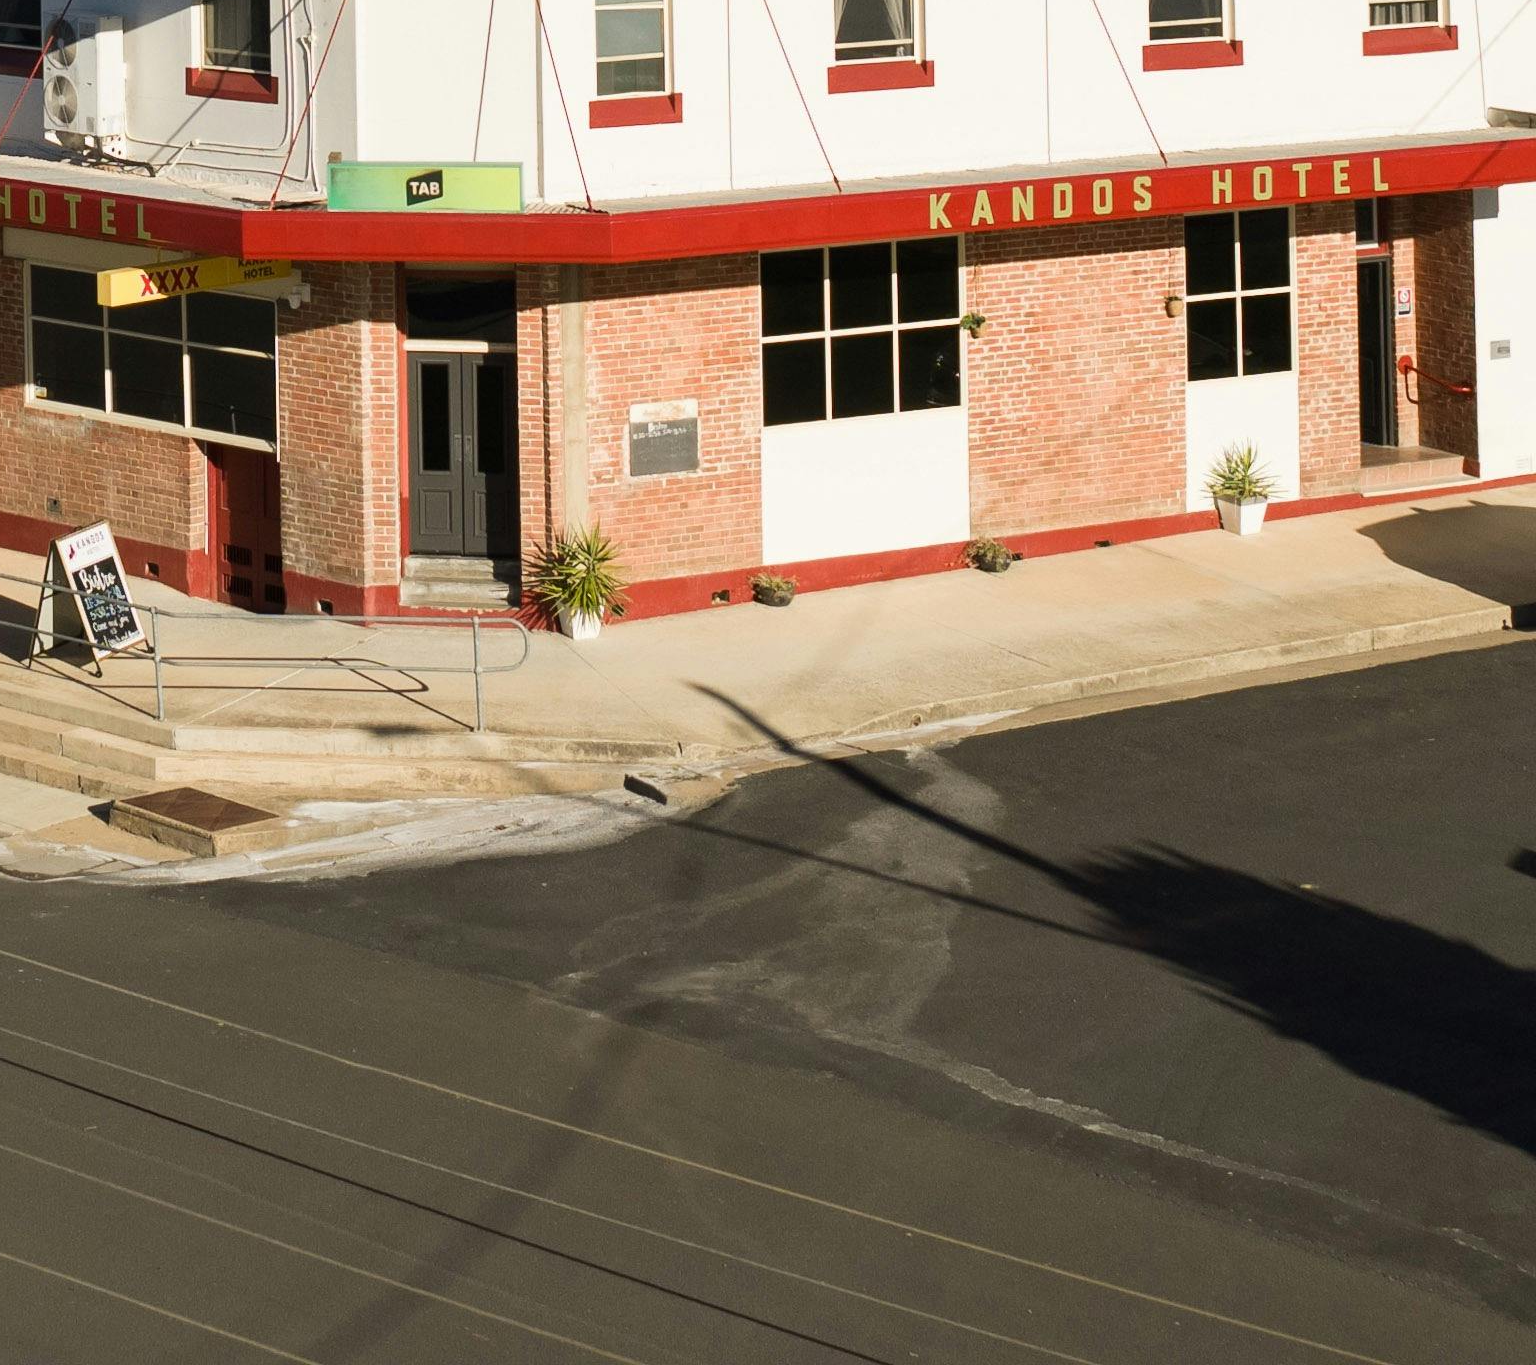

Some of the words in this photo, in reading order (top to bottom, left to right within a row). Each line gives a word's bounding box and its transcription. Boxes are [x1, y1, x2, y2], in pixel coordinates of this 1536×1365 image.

[409, 181, 440, 196] TAB
[929, 176, 1152, 230] KANDOS
[1212, 157, 1389, 205] HOTEL
[141, 265, 200, 296] XXXX
[244, 267, 275, 279] HOTEL
[76, 531, 105, 549] KANDOS
[79, 565, 116, 593] Bistro
